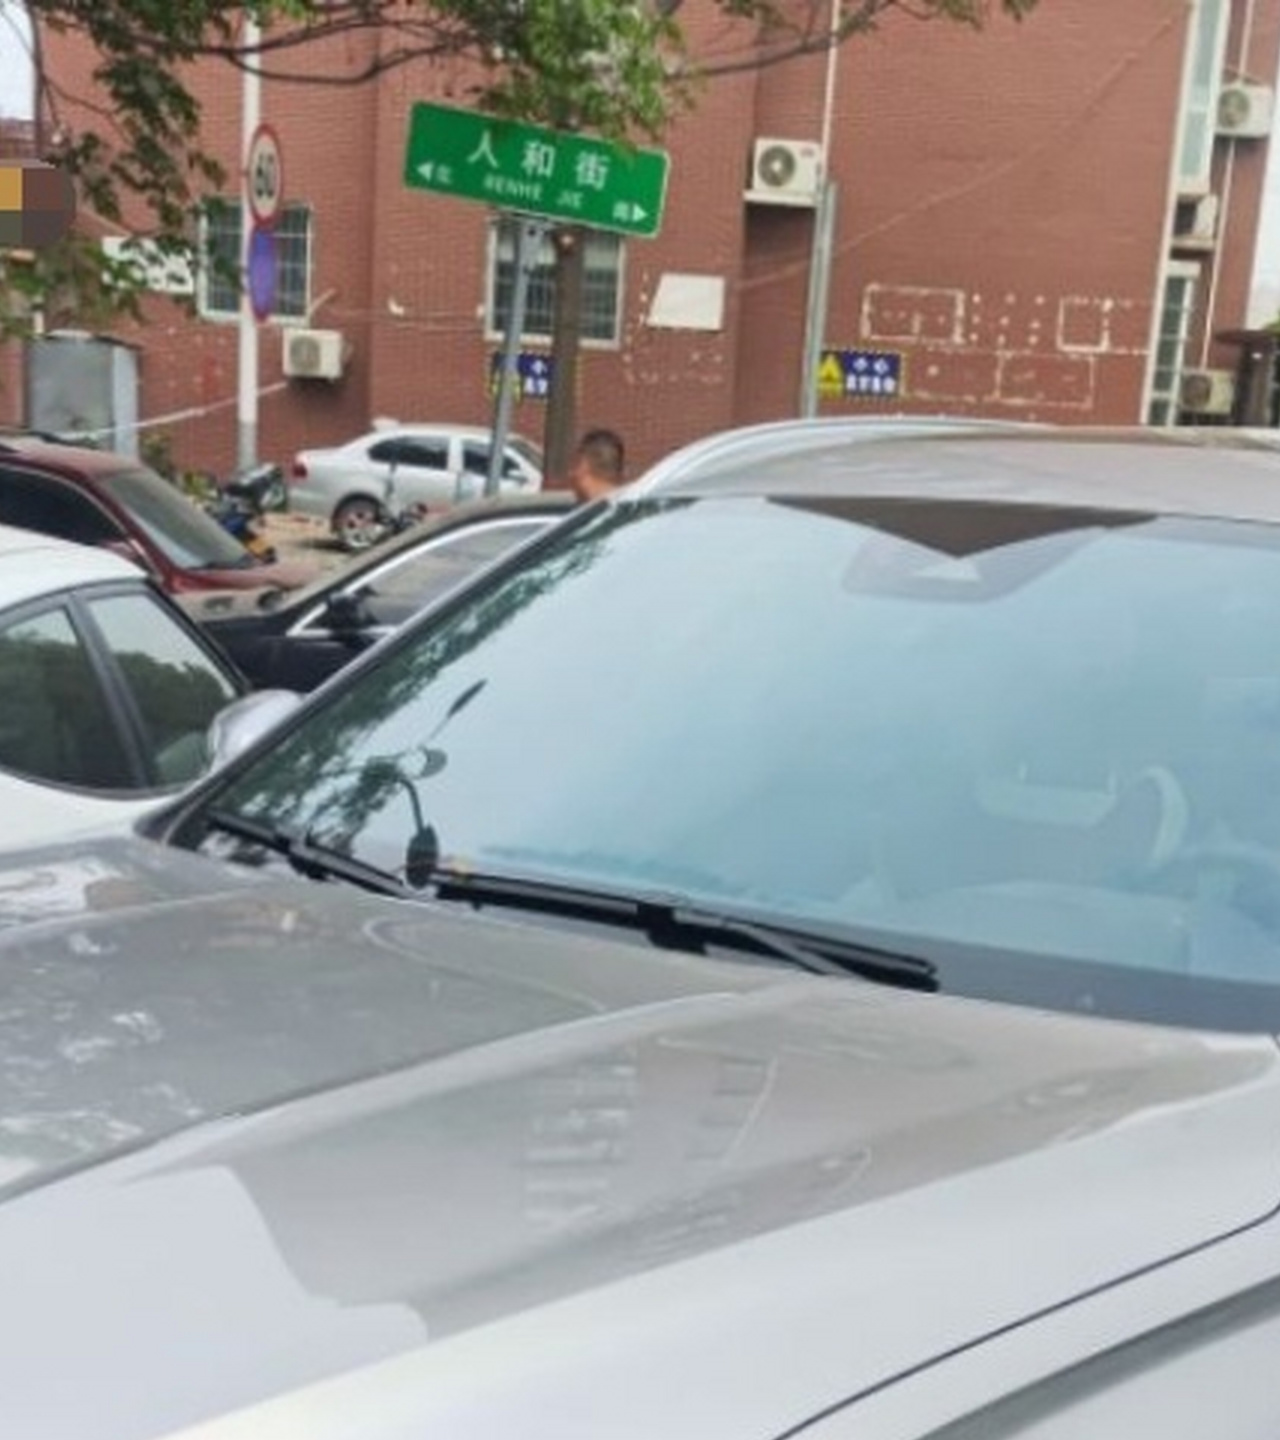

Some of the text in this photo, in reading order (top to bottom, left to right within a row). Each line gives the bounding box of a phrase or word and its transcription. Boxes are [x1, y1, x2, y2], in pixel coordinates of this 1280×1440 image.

[467, 130, 611, 191] 人和街
[483, 173, 543, 201] RENHE
